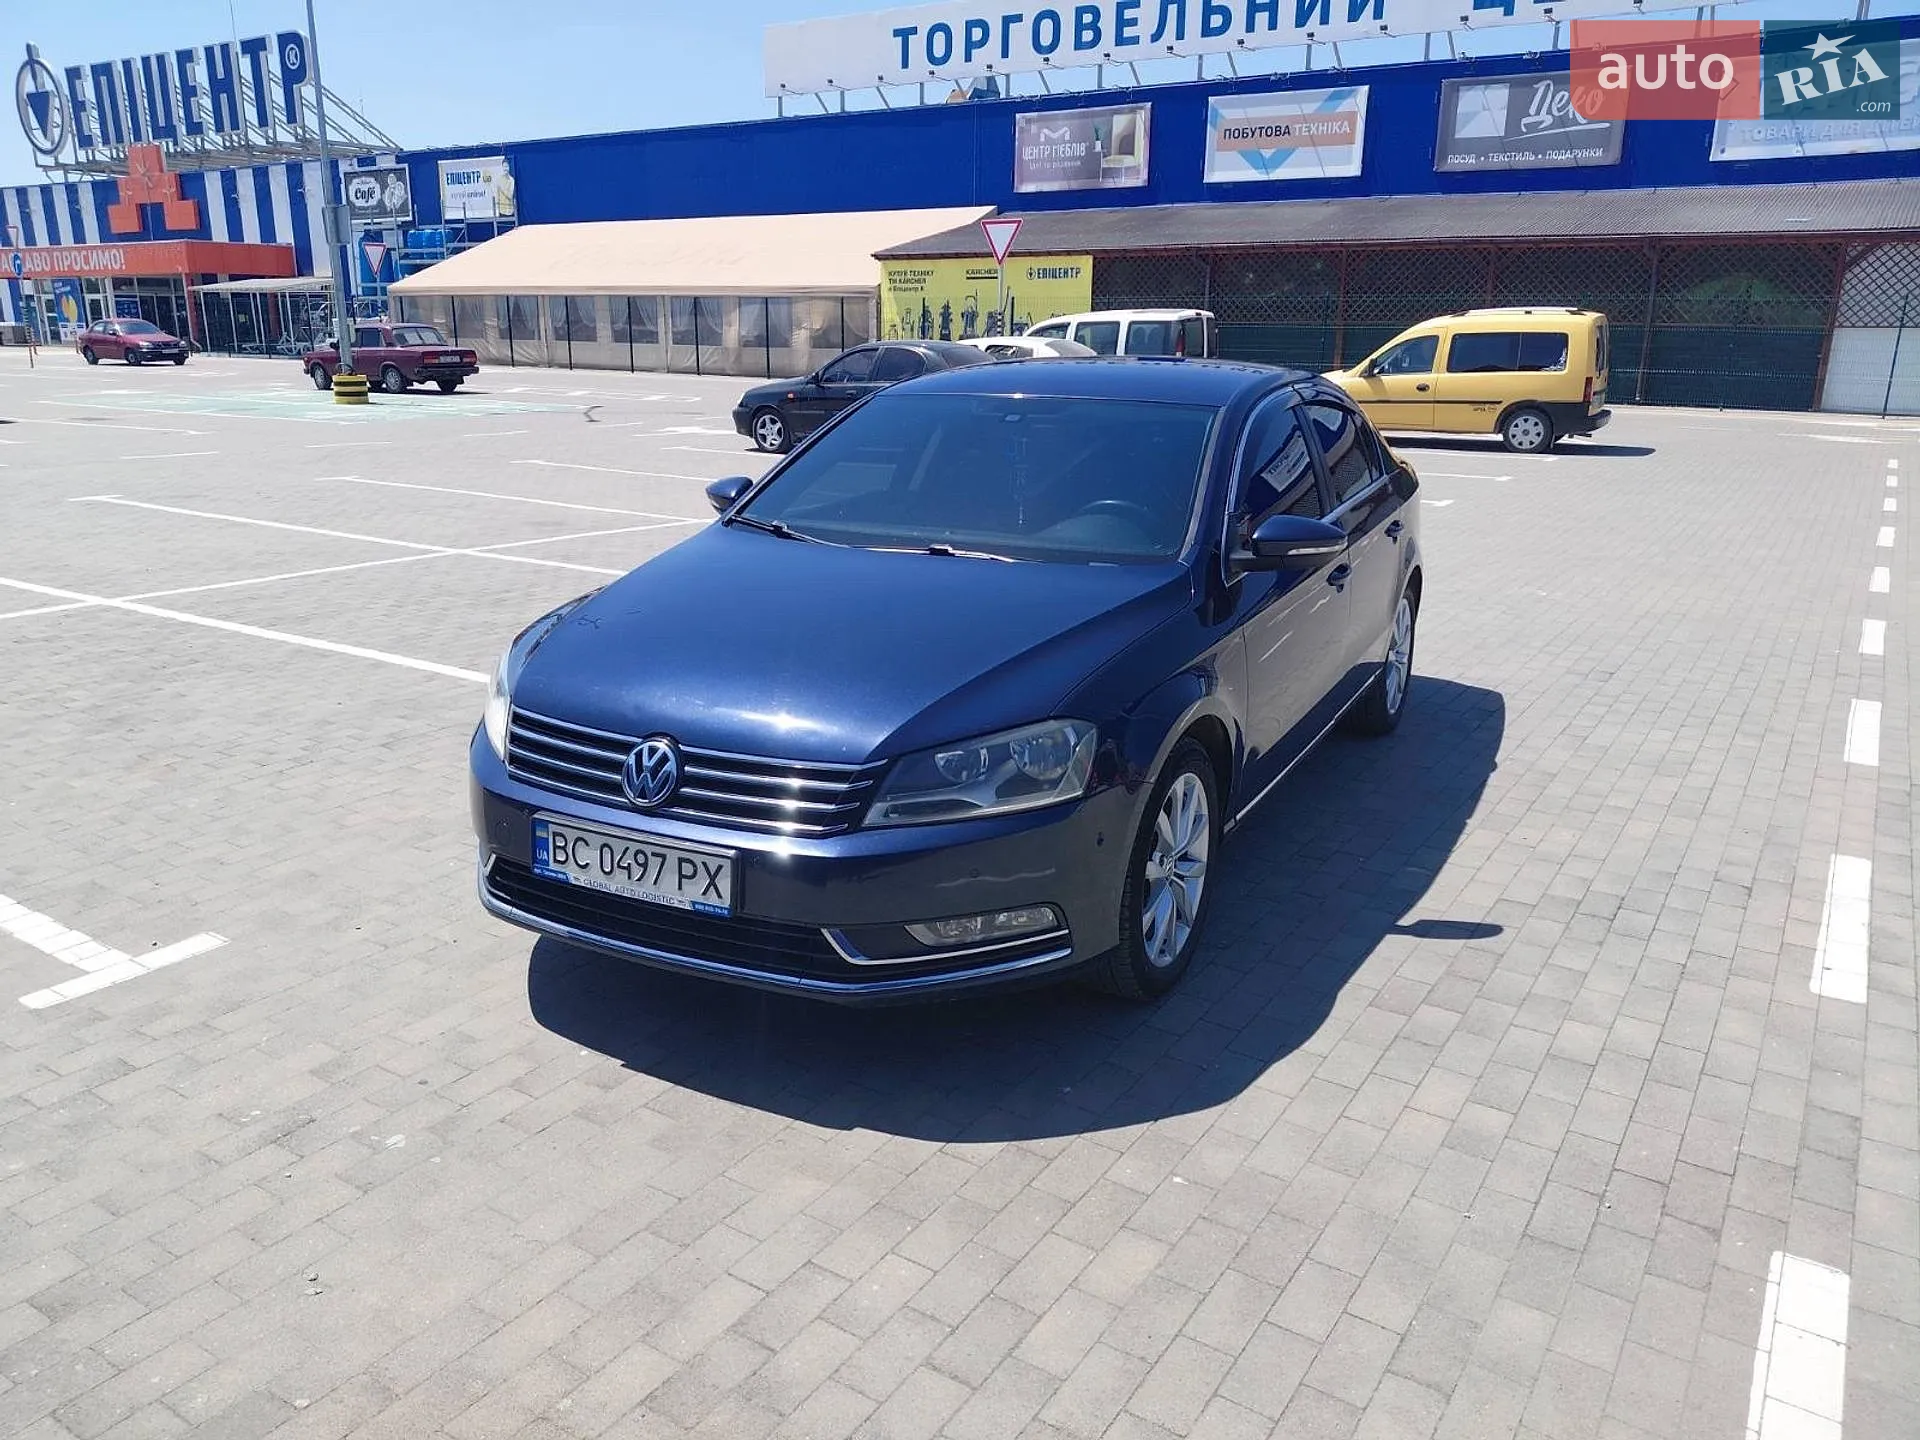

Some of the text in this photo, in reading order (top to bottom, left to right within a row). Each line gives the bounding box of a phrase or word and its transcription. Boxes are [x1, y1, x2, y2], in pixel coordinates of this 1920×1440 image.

[63, 30, 308, 149] ЕПІЦЕНТР
[1222, 120, 1351, 140] ПОБУТОВА ТЕХНІКА
[1022, 145, 1051, 160] ЦЕНТР
[1447, 147, 1604, 164] ПОСУД ТЕКСТИЛЬ ПОДАРУНКИ
[54, 247, 126, 272] ПРОСИМО!
[1036, 267, 1081, 280] ЕПІЦЕНТР
[536, 848, 549, 862] UA
[551, 830, 724, 900] BC 0497 PX
